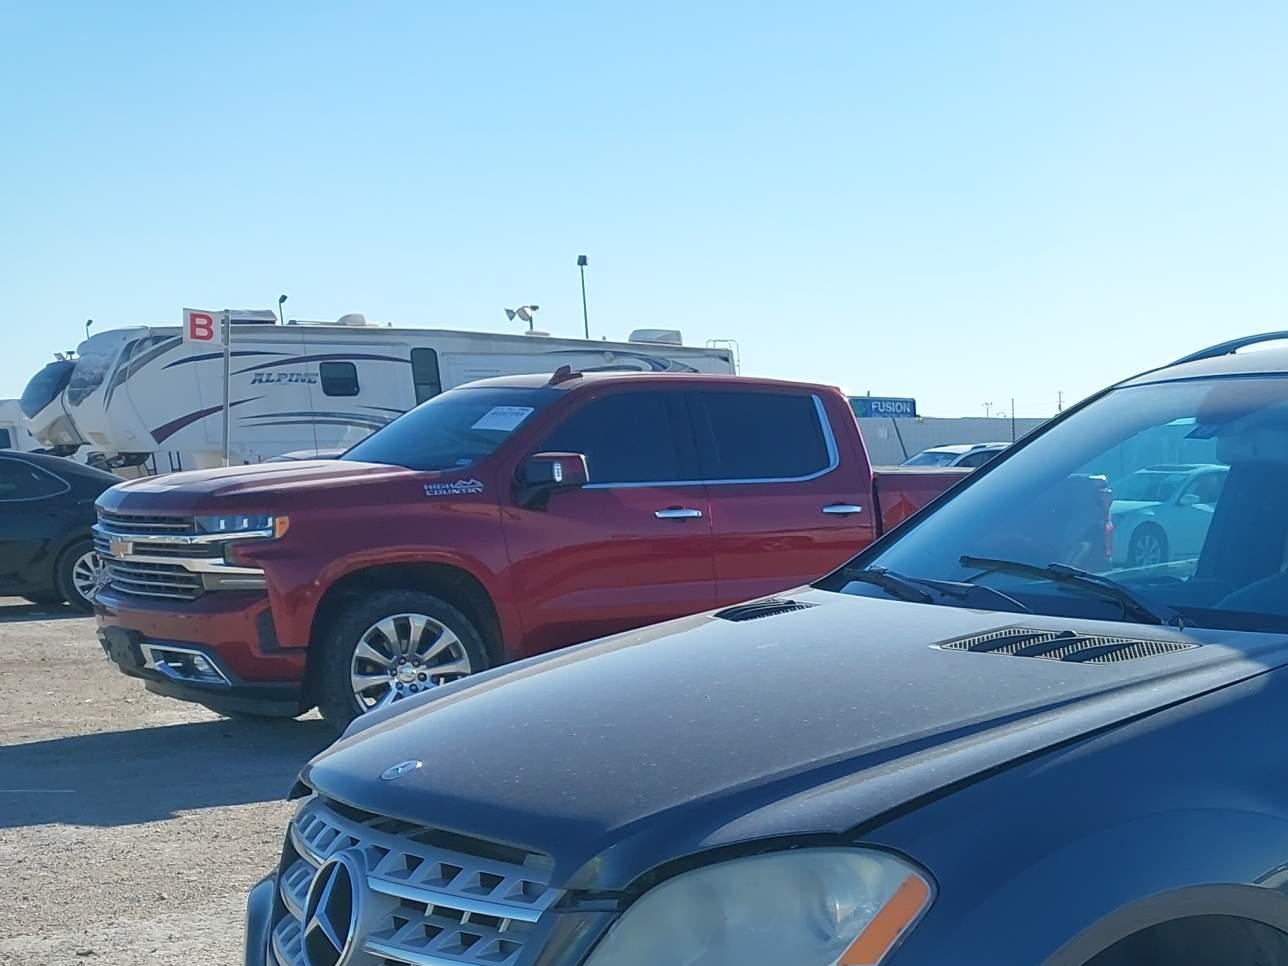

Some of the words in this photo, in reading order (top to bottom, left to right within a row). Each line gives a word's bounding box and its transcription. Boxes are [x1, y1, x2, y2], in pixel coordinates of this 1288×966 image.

[190, 312, 214, 341] B
[251, 372, 318, 385] ALPINE
[871, 401, 911, 413] FUSION
